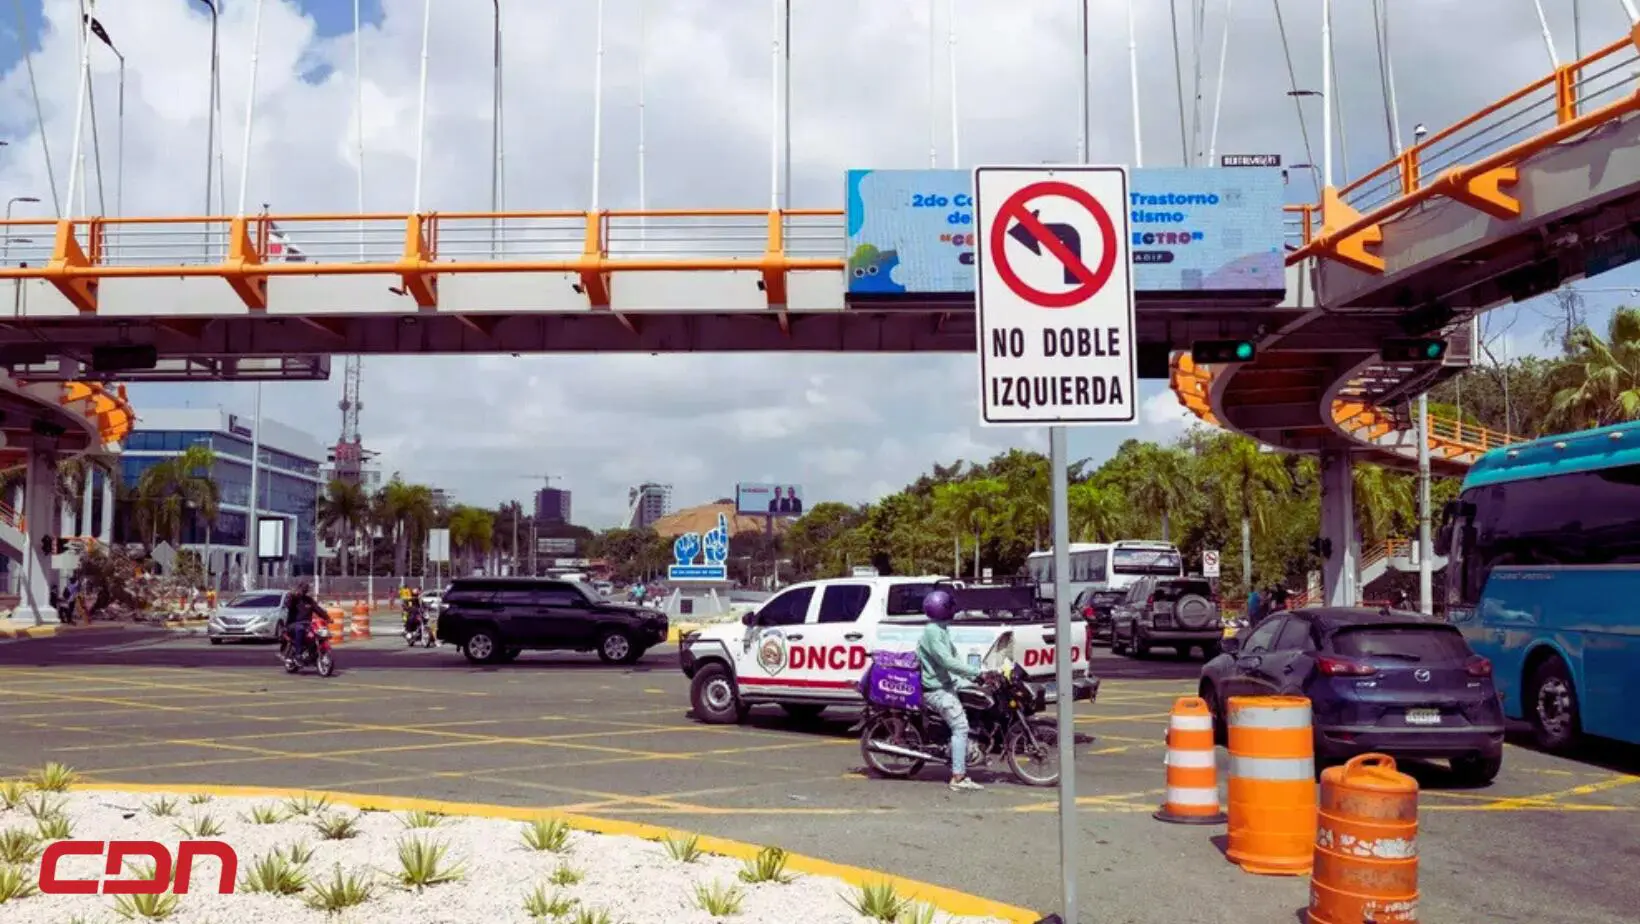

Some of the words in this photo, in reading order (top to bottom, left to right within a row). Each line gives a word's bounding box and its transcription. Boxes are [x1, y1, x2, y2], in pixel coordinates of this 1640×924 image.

[912, 193, 949, 208] 2do
[1130, 192, 1219, 206] Trastorno
[992, 327, 1025, 358] NO
[1043, 327, 1120, 357] DOBLE
[992, 375, 1123, 409] IZQUIERDA
[788, 645, 866, 671] DNCD
[1023, 645, 1080, 667] DND
